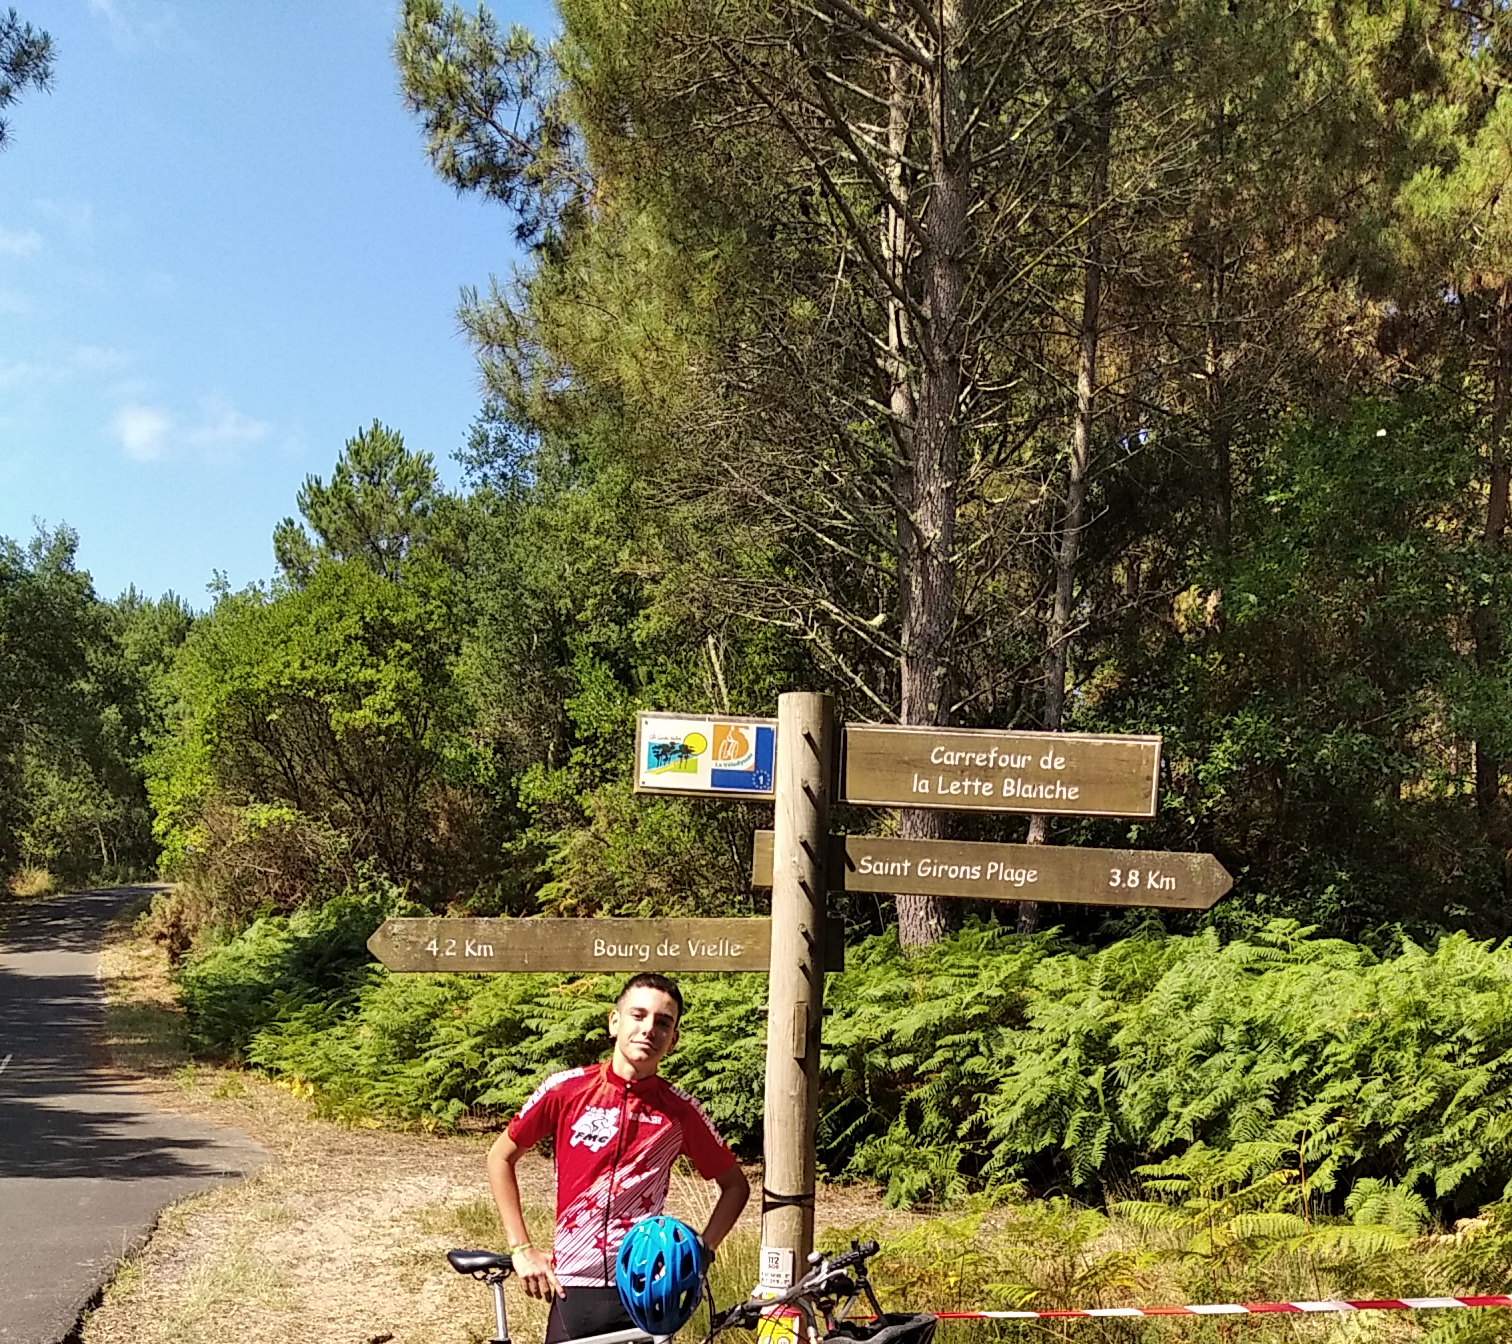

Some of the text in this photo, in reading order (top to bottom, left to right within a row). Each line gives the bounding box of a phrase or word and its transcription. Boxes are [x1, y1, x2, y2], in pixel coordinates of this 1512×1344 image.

[930, 745, 1066, 770] Carrefour de
[758, 775, 764, 785] 1
[912, 774, 1080, 801] la Lette Blanche
[858, 856, 1038, 887] Saint Girons Plage
[1108, 868, 1177, 891] 3.8 Km
[425, 938, 494, 958] 4.2 Km
[593, 936, 742, 962] Bourg de Vielle
[768, 1256, 779, 1264] 112
